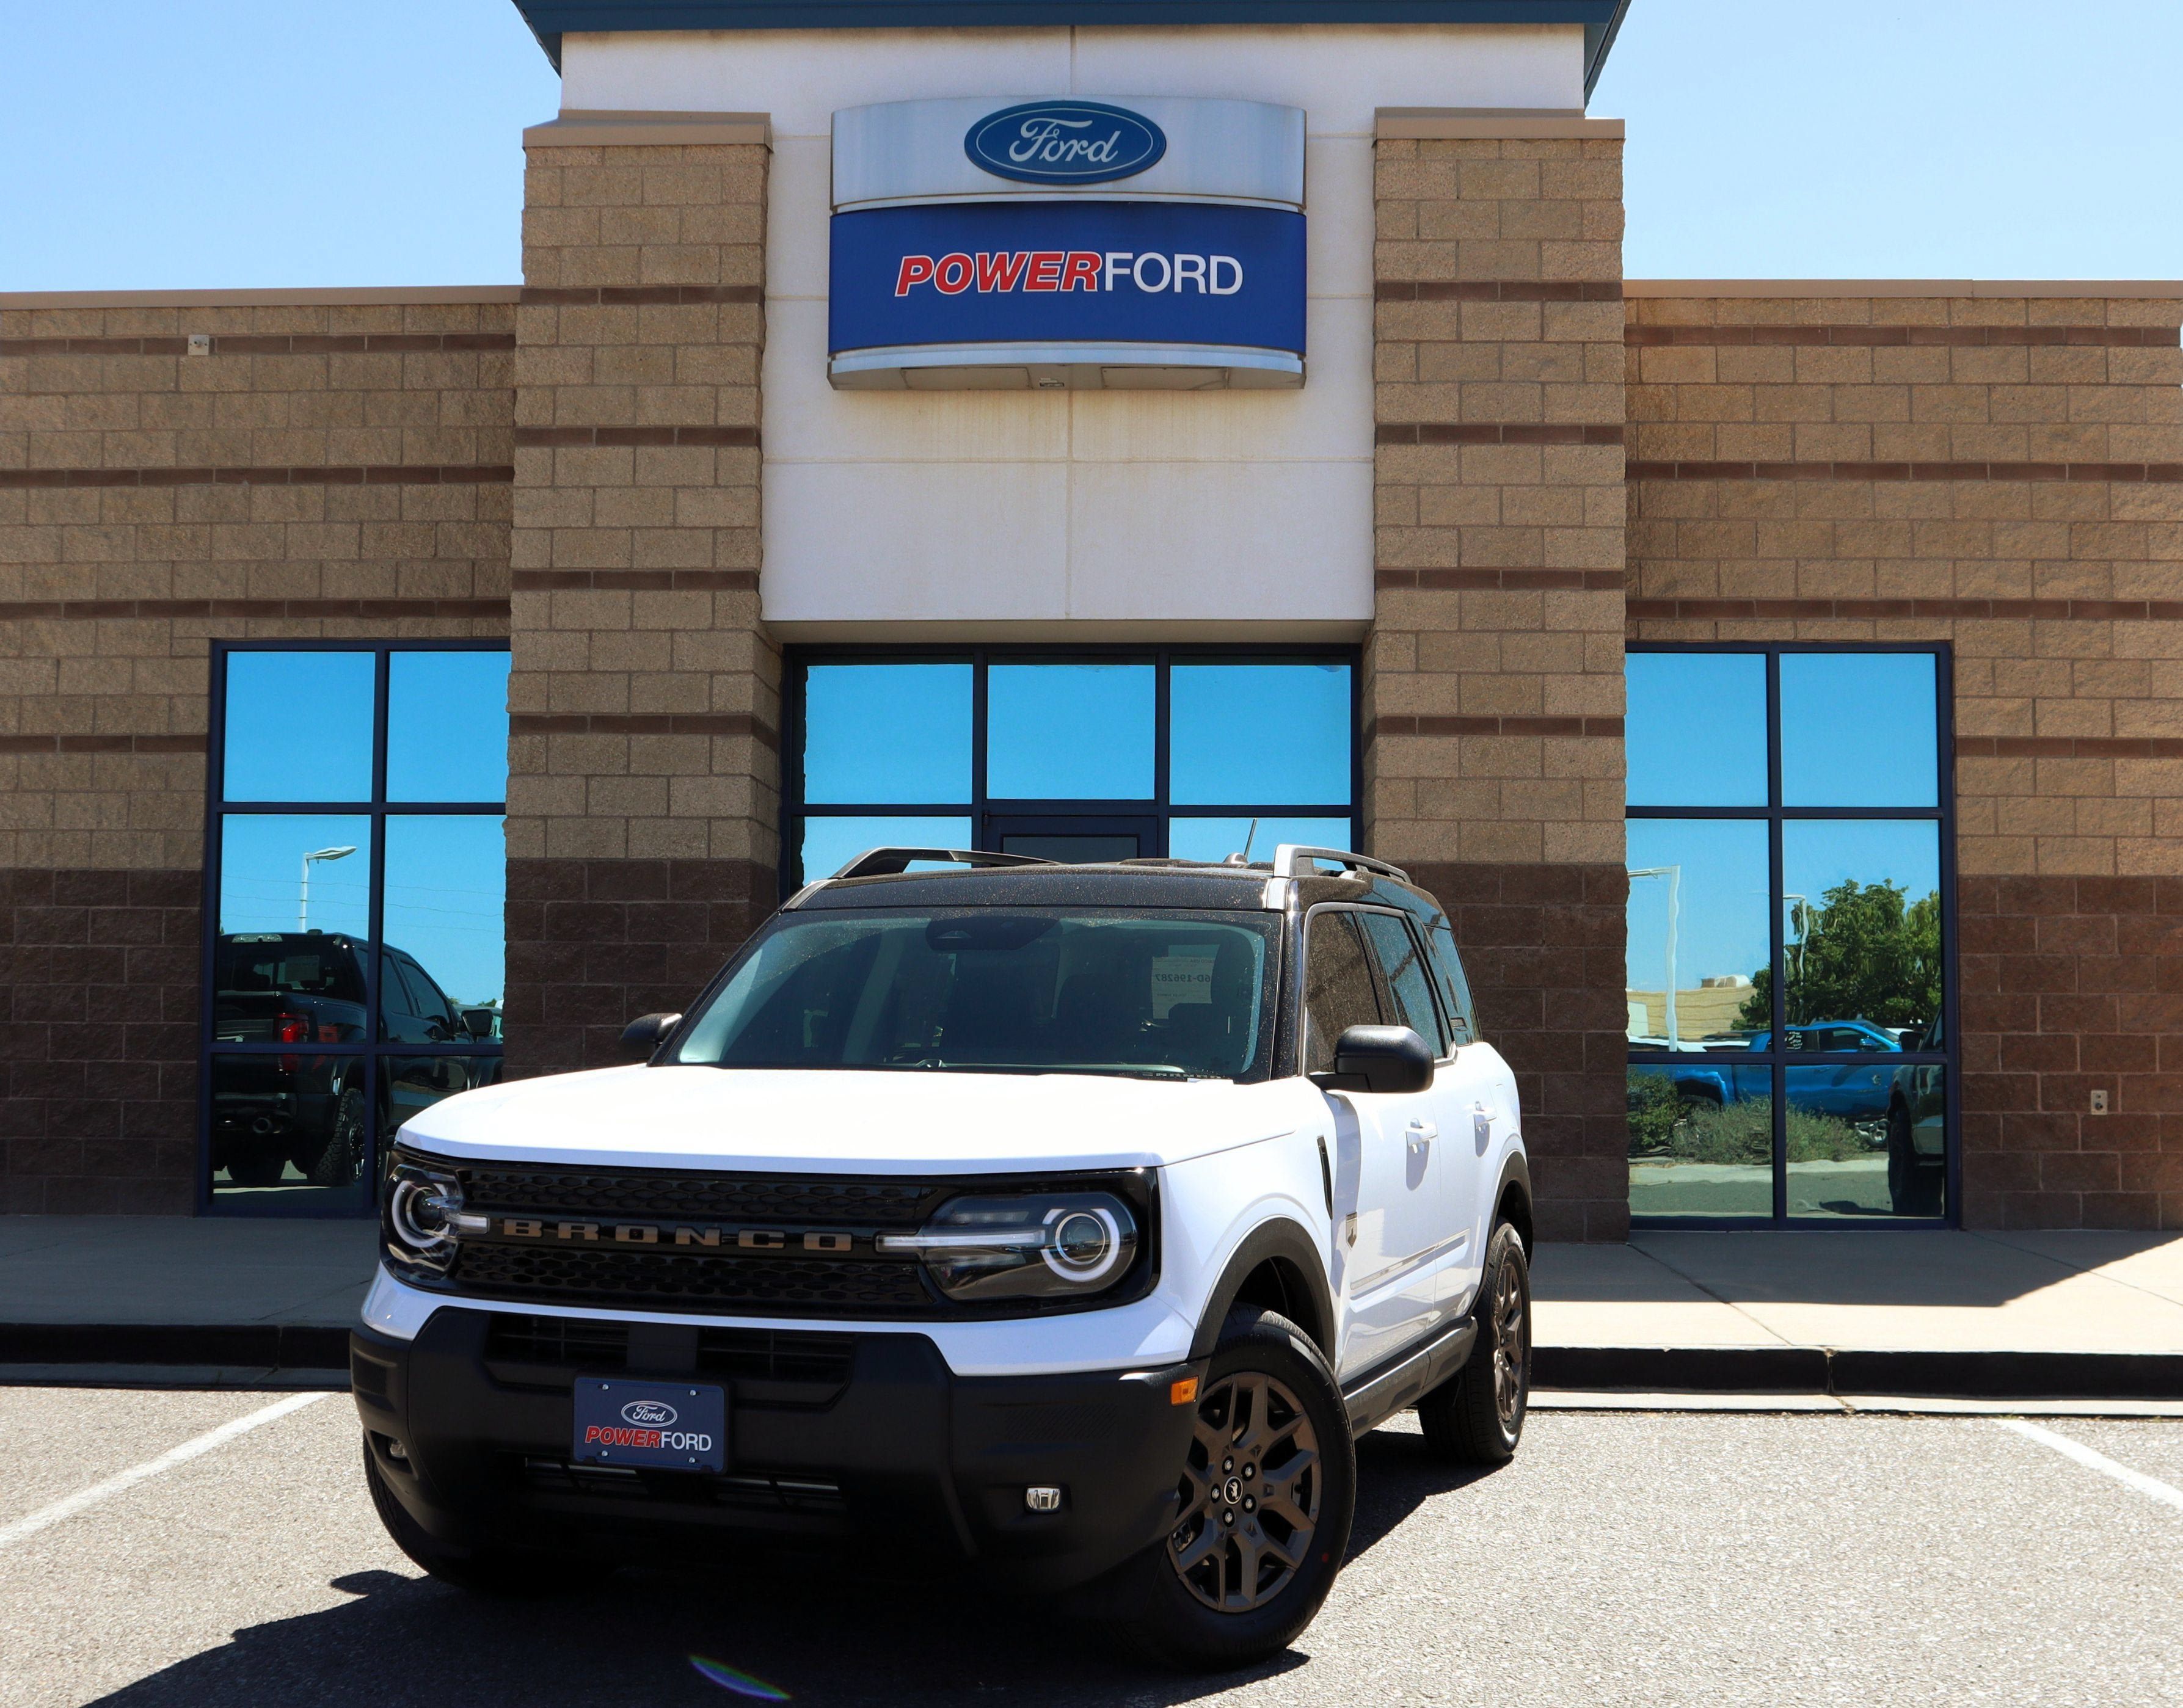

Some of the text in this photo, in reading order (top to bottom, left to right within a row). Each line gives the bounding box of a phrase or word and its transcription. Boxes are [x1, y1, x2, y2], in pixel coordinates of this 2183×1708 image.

[1008, 117, 1121, 164] Ford
[503, 1218, 855, 1251] BRONCO
[632, 1405, 666, 1422] Ford
